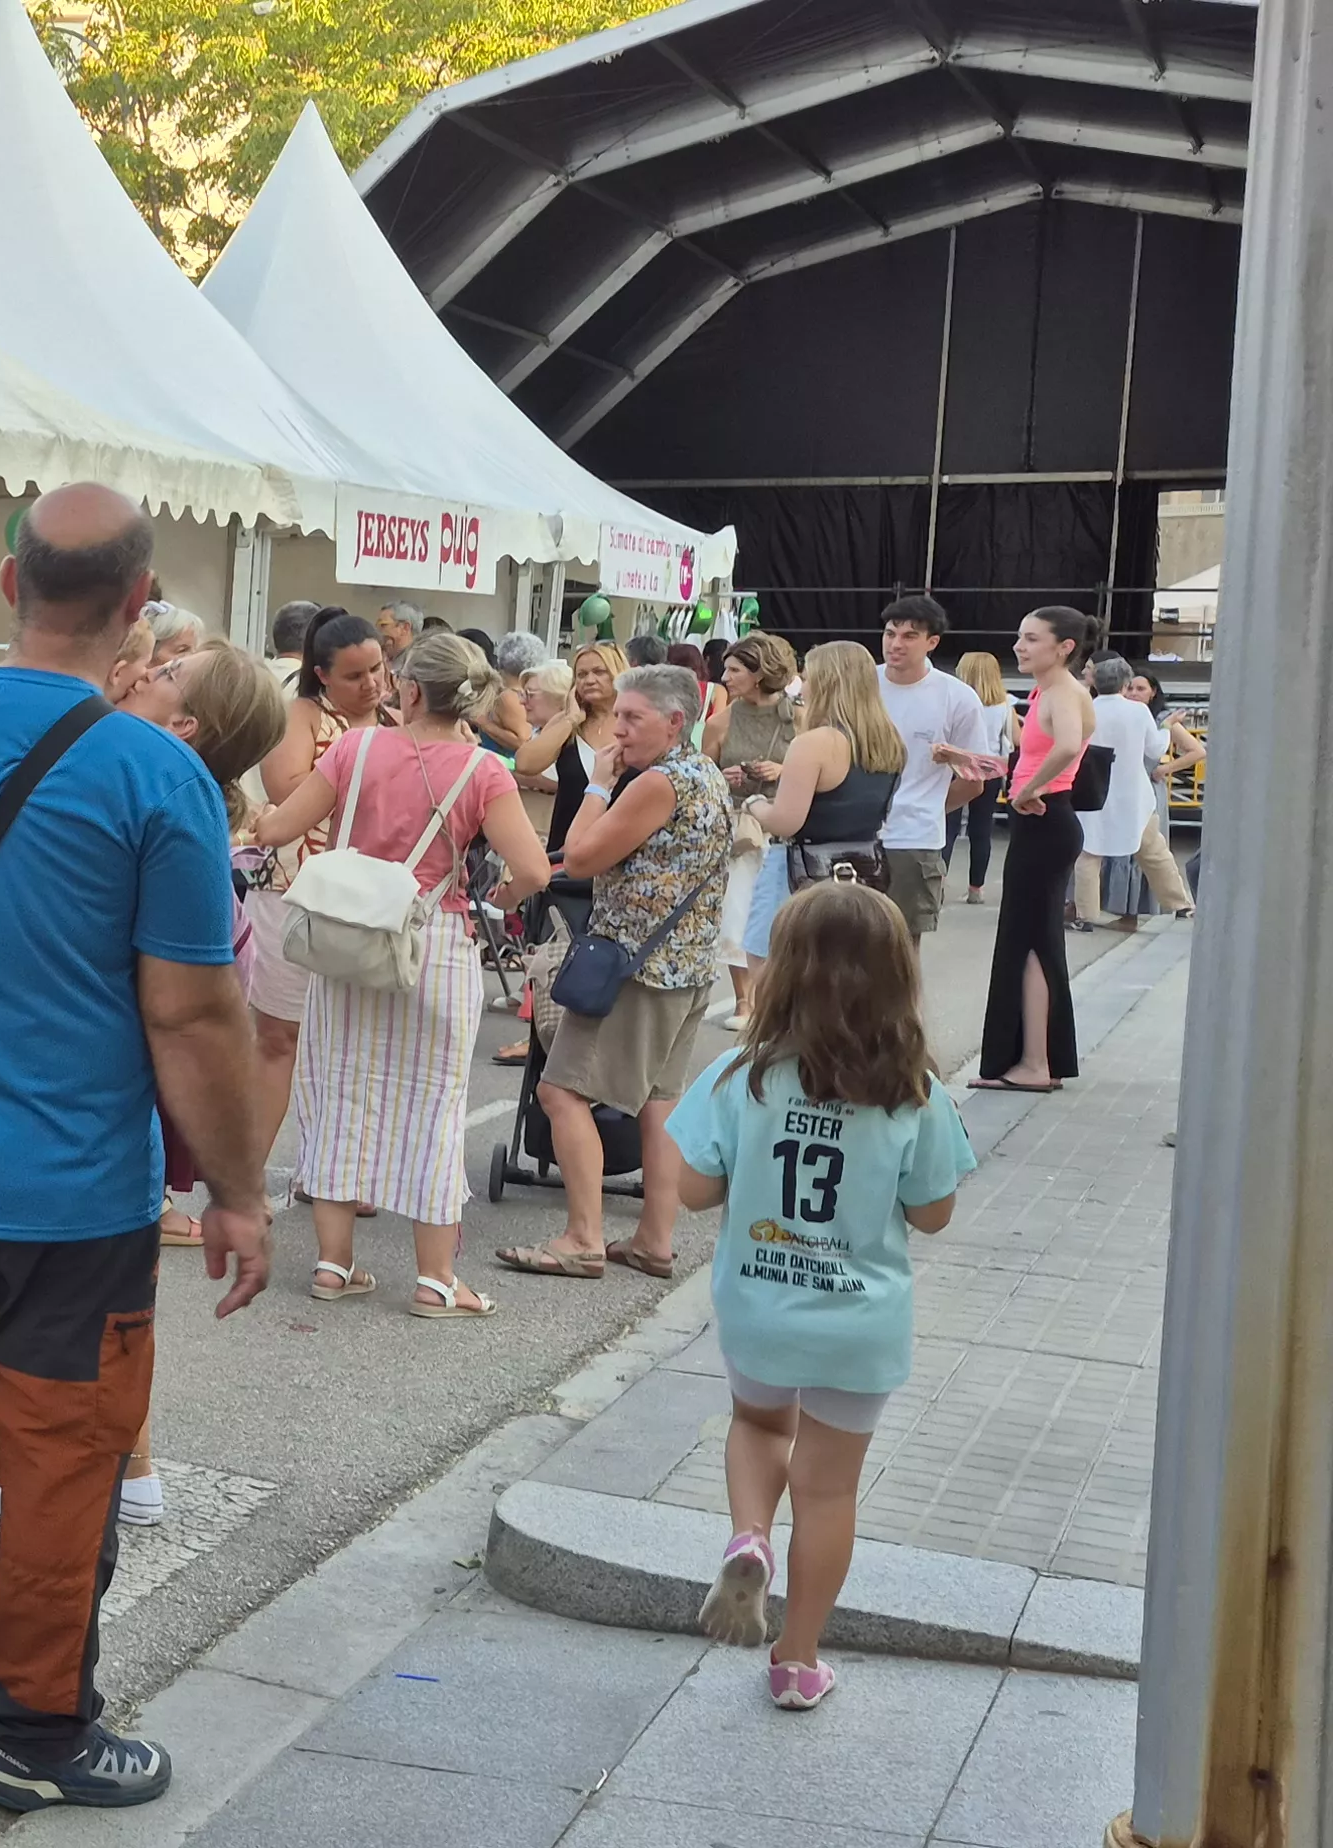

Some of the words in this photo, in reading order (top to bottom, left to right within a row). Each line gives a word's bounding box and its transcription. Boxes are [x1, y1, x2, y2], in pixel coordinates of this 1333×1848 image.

[354, 510, 430, 569] JERSEYS
[439, 504, 481, 590] puig
[785, 1110, 843, 1141] ESTER
[773, 1139, 845, 1223] 13
[756, 1248, 786, 1267] CLUB
[740, 1263, 788, 1284] ALMUNIA
[792, 1271, 809, 1287] DE
[812, 1276, 834, 1293] SAN
[839, 1278, 866, 1293] JUAN
